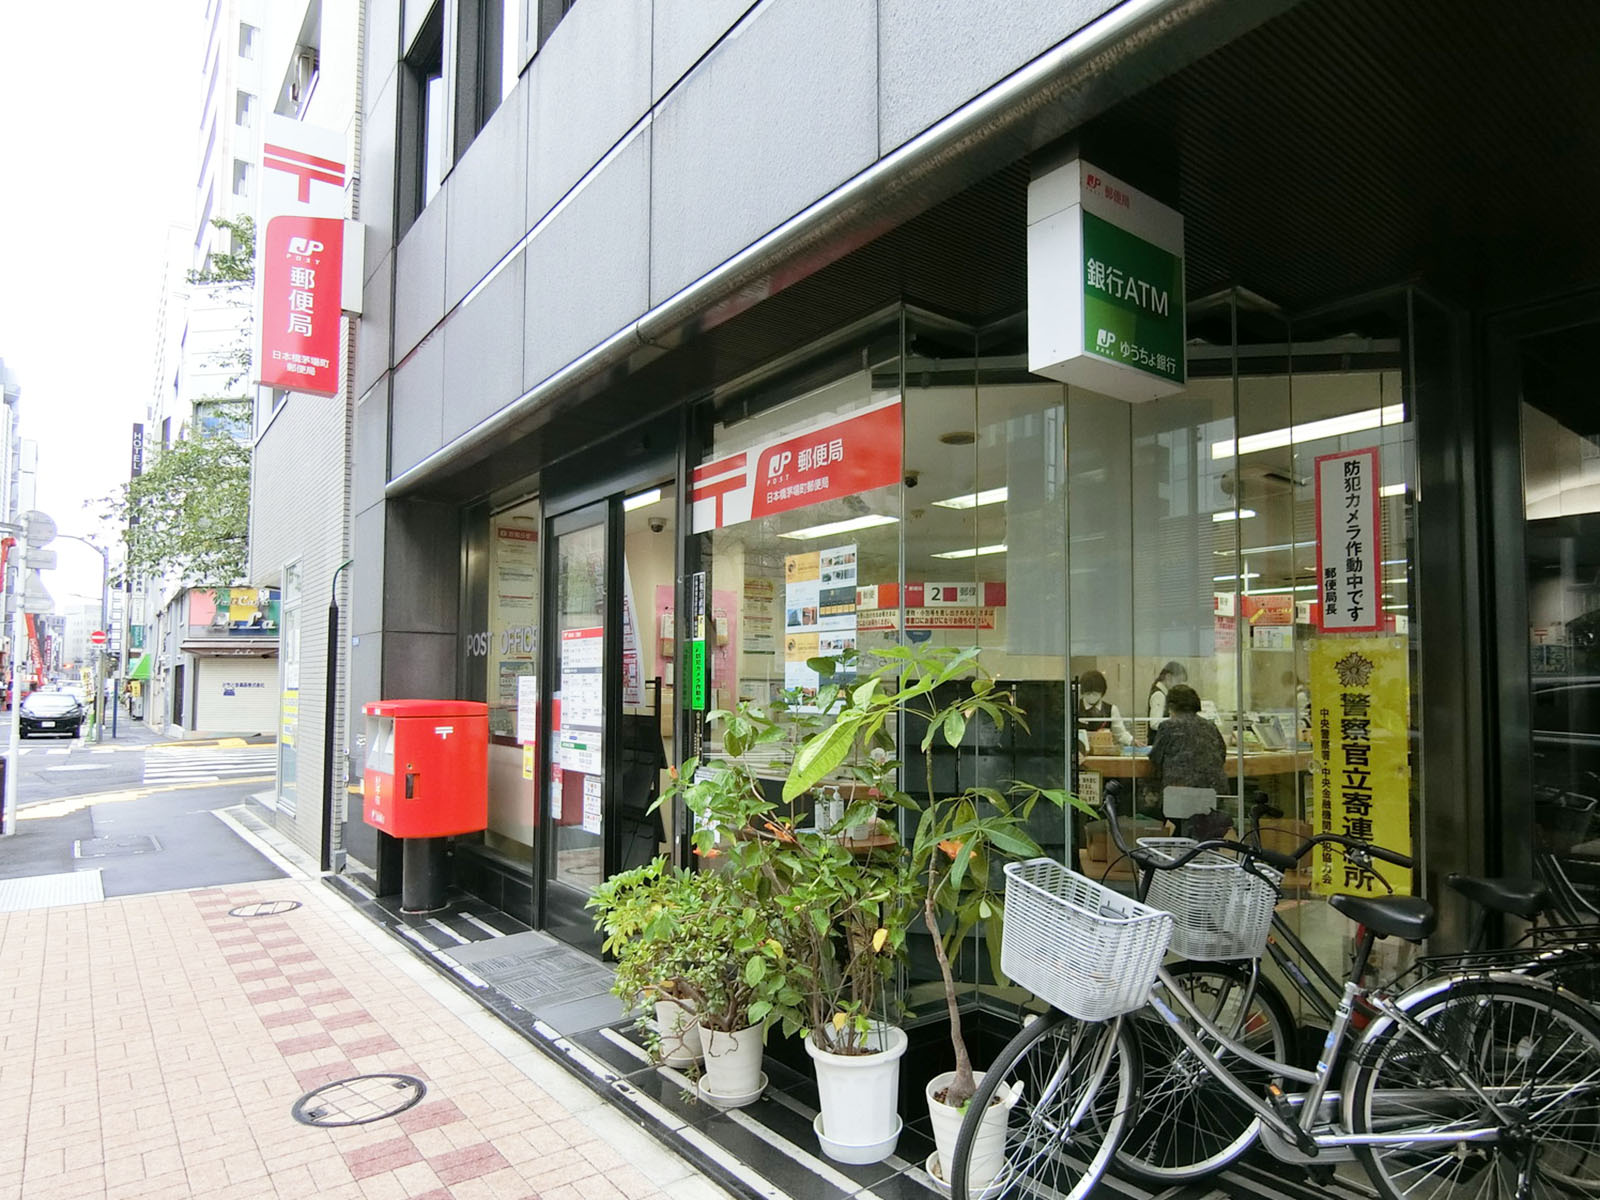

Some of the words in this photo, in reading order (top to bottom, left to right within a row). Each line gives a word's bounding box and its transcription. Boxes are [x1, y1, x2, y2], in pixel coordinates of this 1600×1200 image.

[288, 266, 315, 337] 郵便局
[1087, 257, 1169, 318] 銀行ATM
[286, 363, 317, 377] 郵便局
[1120, 341, 1177, 375] ゆうちょ銀行
[133, 432, 142, 470] HOTEL
[797, 437, 844, 473] 郵便局
[766, 475, 829, 504] 日本橋茅場町郵便局
[1343, 460, 1364, 622] 防犯カメラ作動中です
[931, 587, 941, 601] 2
[1324, 567, 1338, 616] 郵便局長
[467, 632, 492, 656] POST
[1320, 707, 1333, 885] 中央警察署・中央金融機関犯協力会
[1340, 692, 1375, 892] 警察官立寄連所
